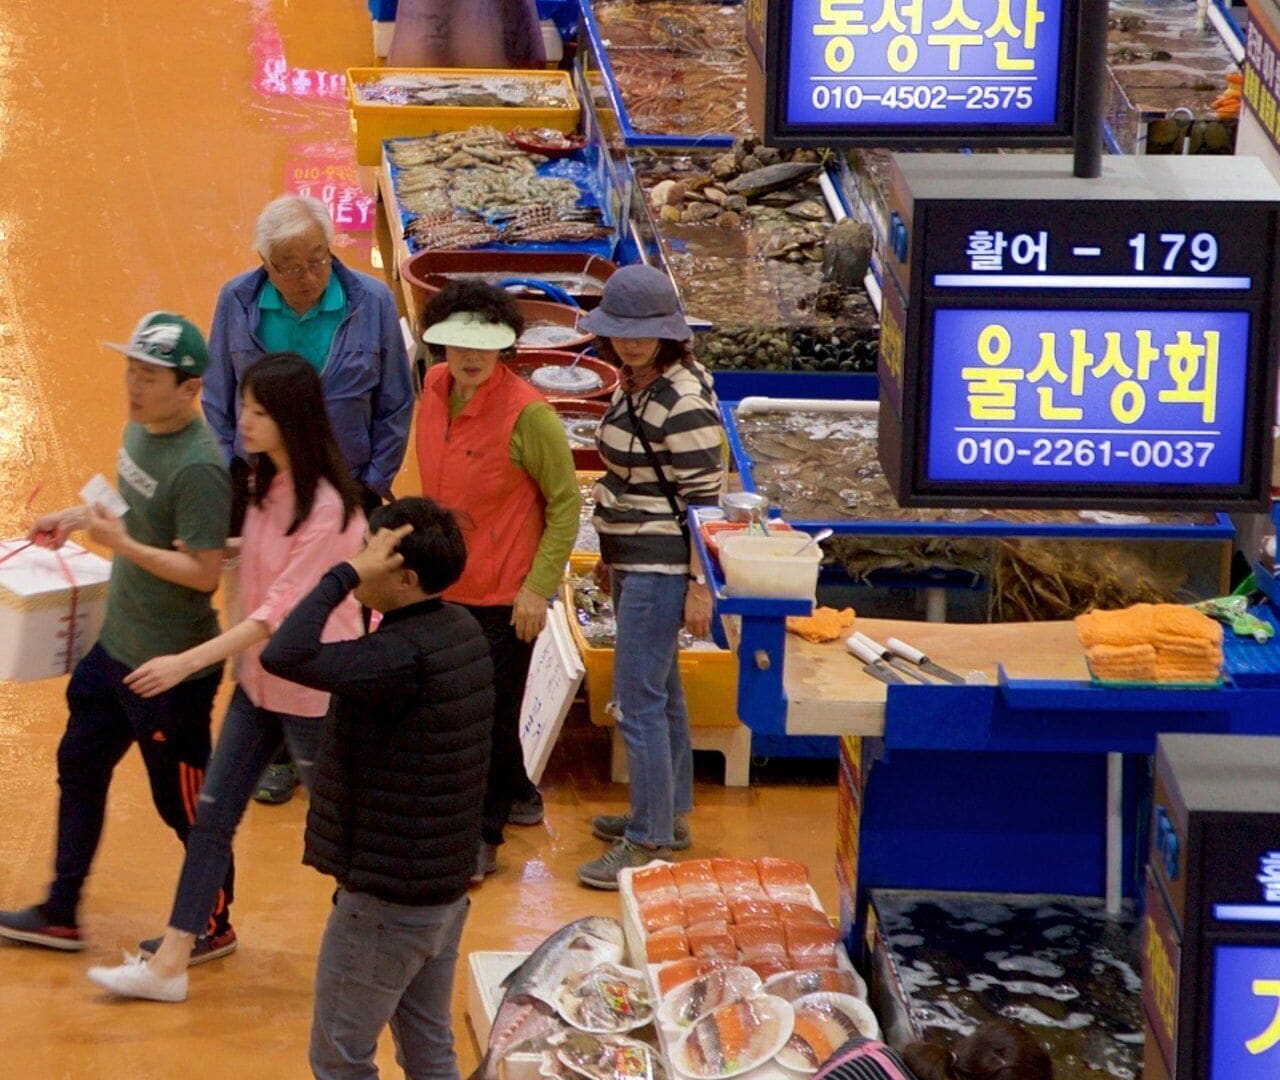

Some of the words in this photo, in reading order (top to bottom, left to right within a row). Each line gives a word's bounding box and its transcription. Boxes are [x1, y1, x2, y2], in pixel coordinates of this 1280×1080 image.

[811, 84, 1033, 110] 010-4502-2575
[966, 230, 1048, 272] 활어
[1128, 232, 1219, 273] 179
[960, 324, 1220, 425] 울산상회
[956, 436, 1216, 468] 010-2261-0037
